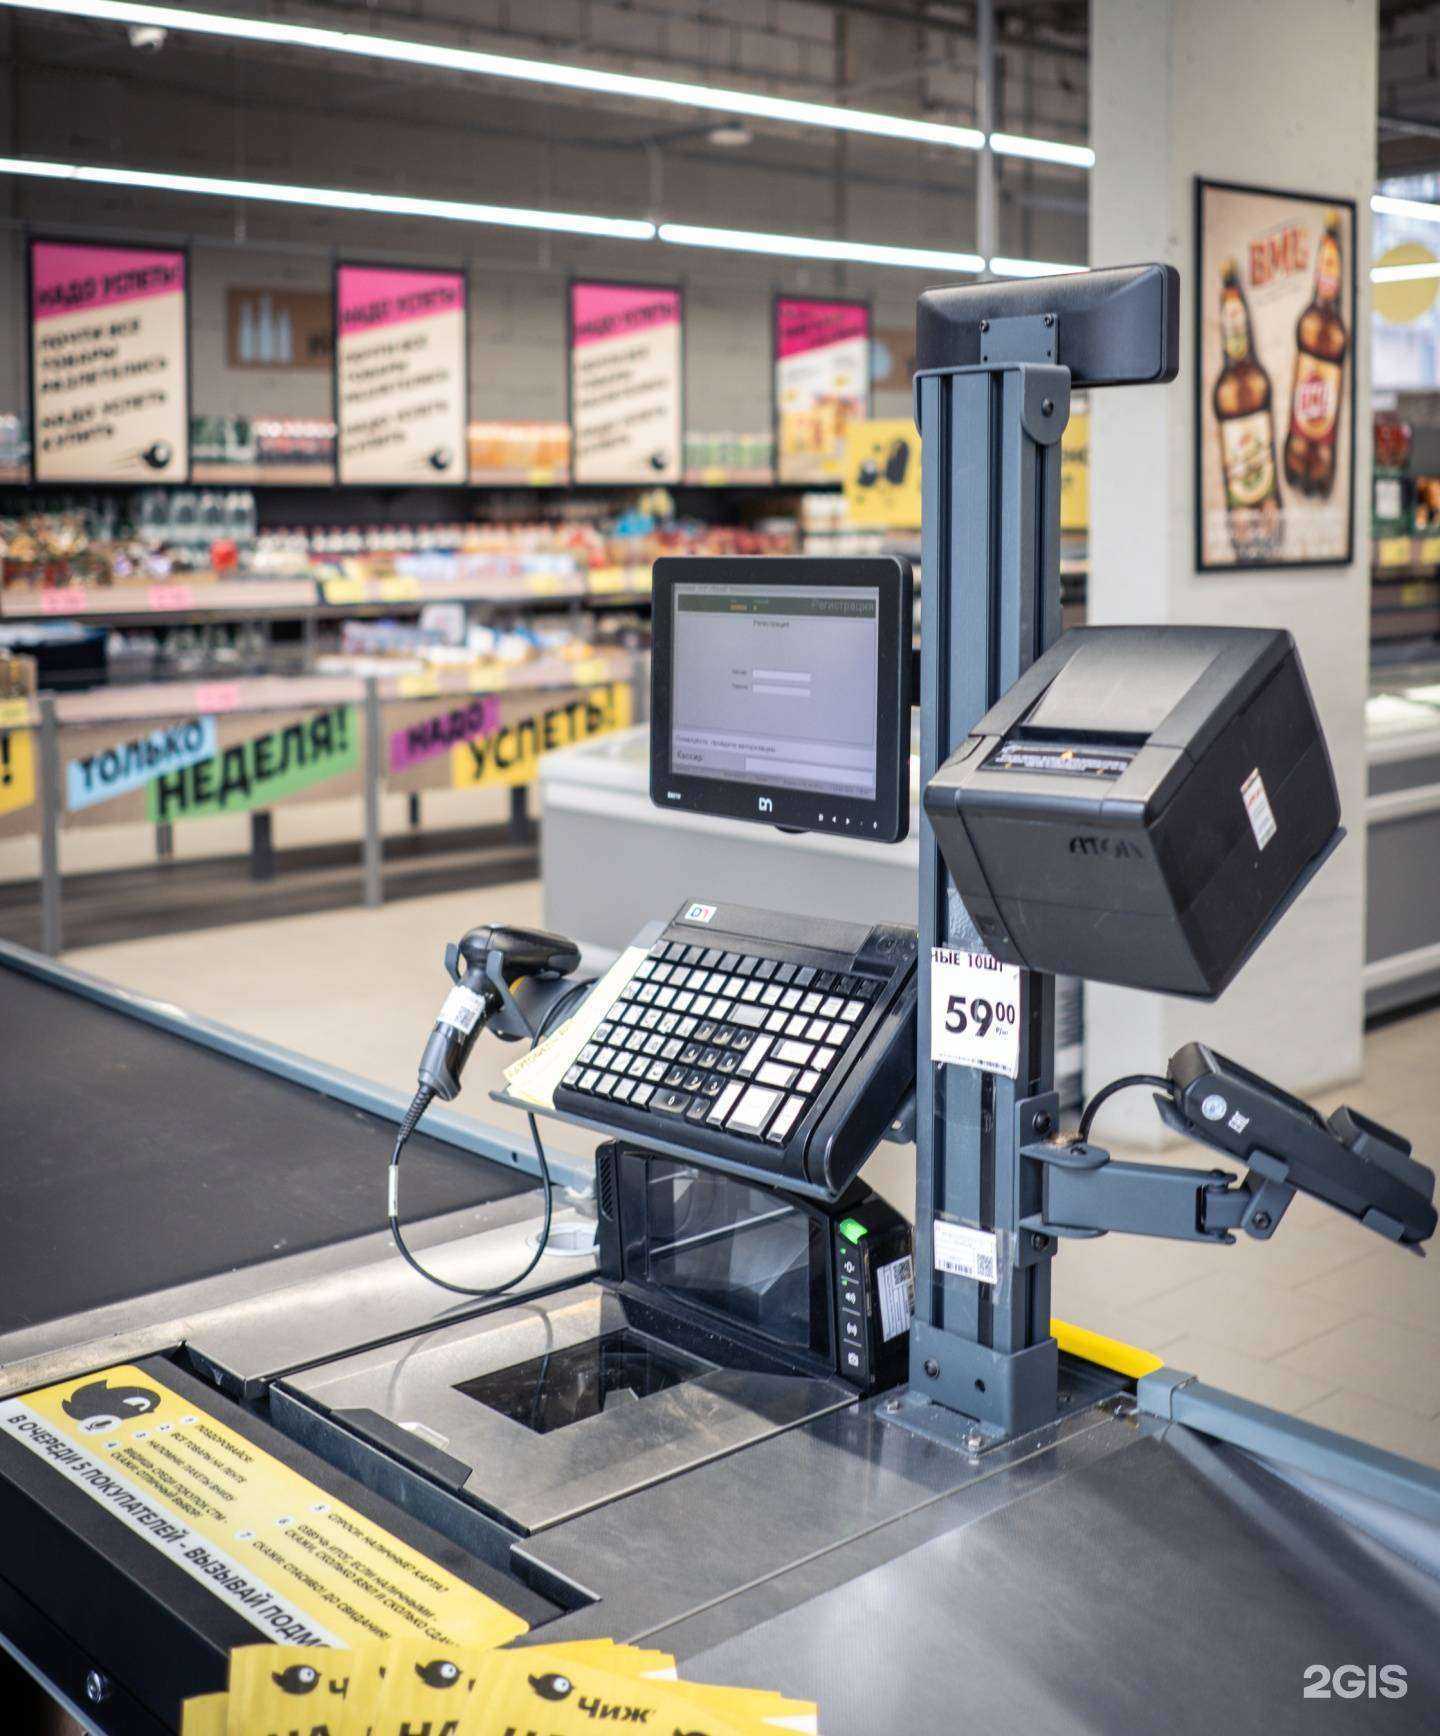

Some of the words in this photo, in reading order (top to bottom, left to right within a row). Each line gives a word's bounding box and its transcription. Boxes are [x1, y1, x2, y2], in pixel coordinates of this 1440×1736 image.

[77, 718, 207, 791] ТОЛЬКО
[158, 703, 351, 817] НЕДЕЛЯ!
[406, 701, 488, 754] НАДО
[470, 690, 618, 780] УСПЕТЬ!
[7, 1412, 19, 1424] В
[18, 1421, 75, 1470] ОЧЕРЕДИ
[71, 1460, 84, 1473] 5
[81, 1466, 187, 1547] ПОКУПАТЕЛЕЙ
[184, 1547, 273, 1611] ВЫЗЫВАЙ
